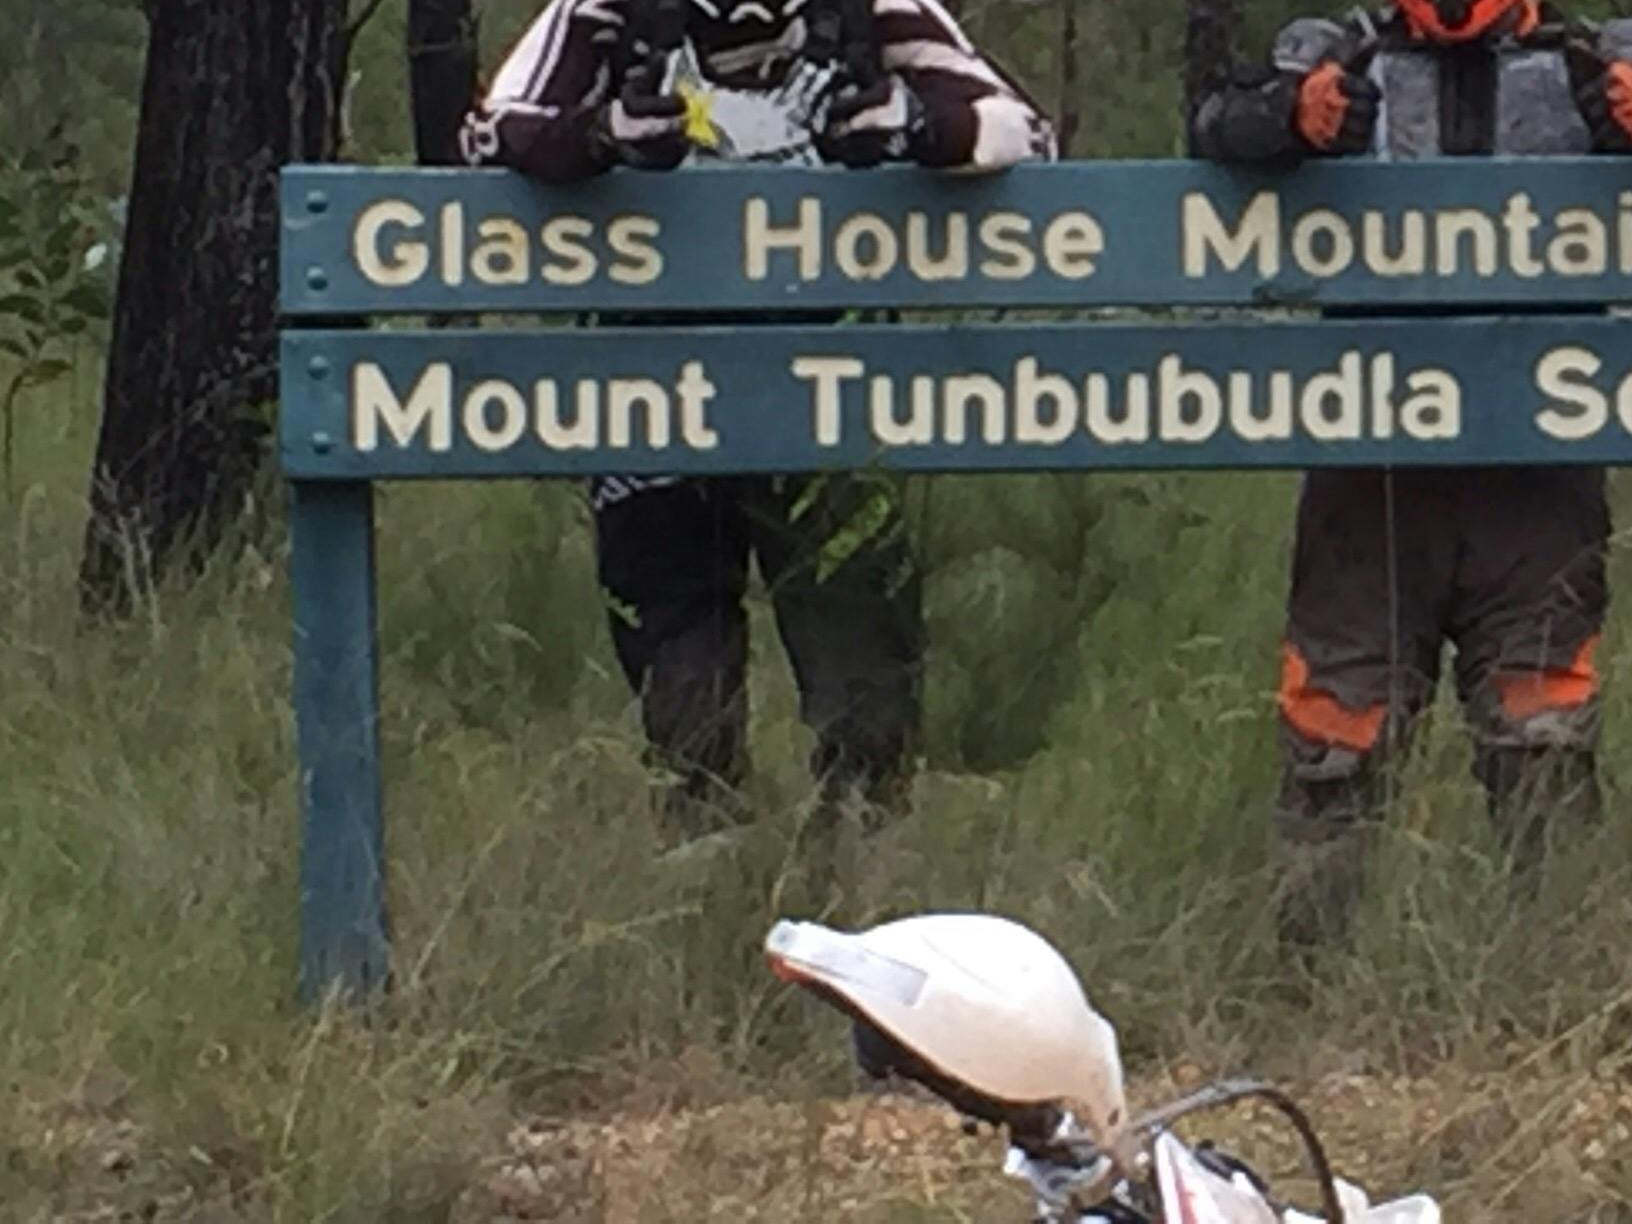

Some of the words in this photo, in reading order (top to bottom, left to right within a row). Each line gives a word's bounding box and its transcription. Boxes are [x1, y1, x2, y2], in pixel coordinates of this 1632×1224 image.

[352, 198, 663, 288] Glass
[744, 194, 1105, 283] House
[353, 361, 719, 453] Mount
[791, 350, 1463, 451] Tunbubudla
